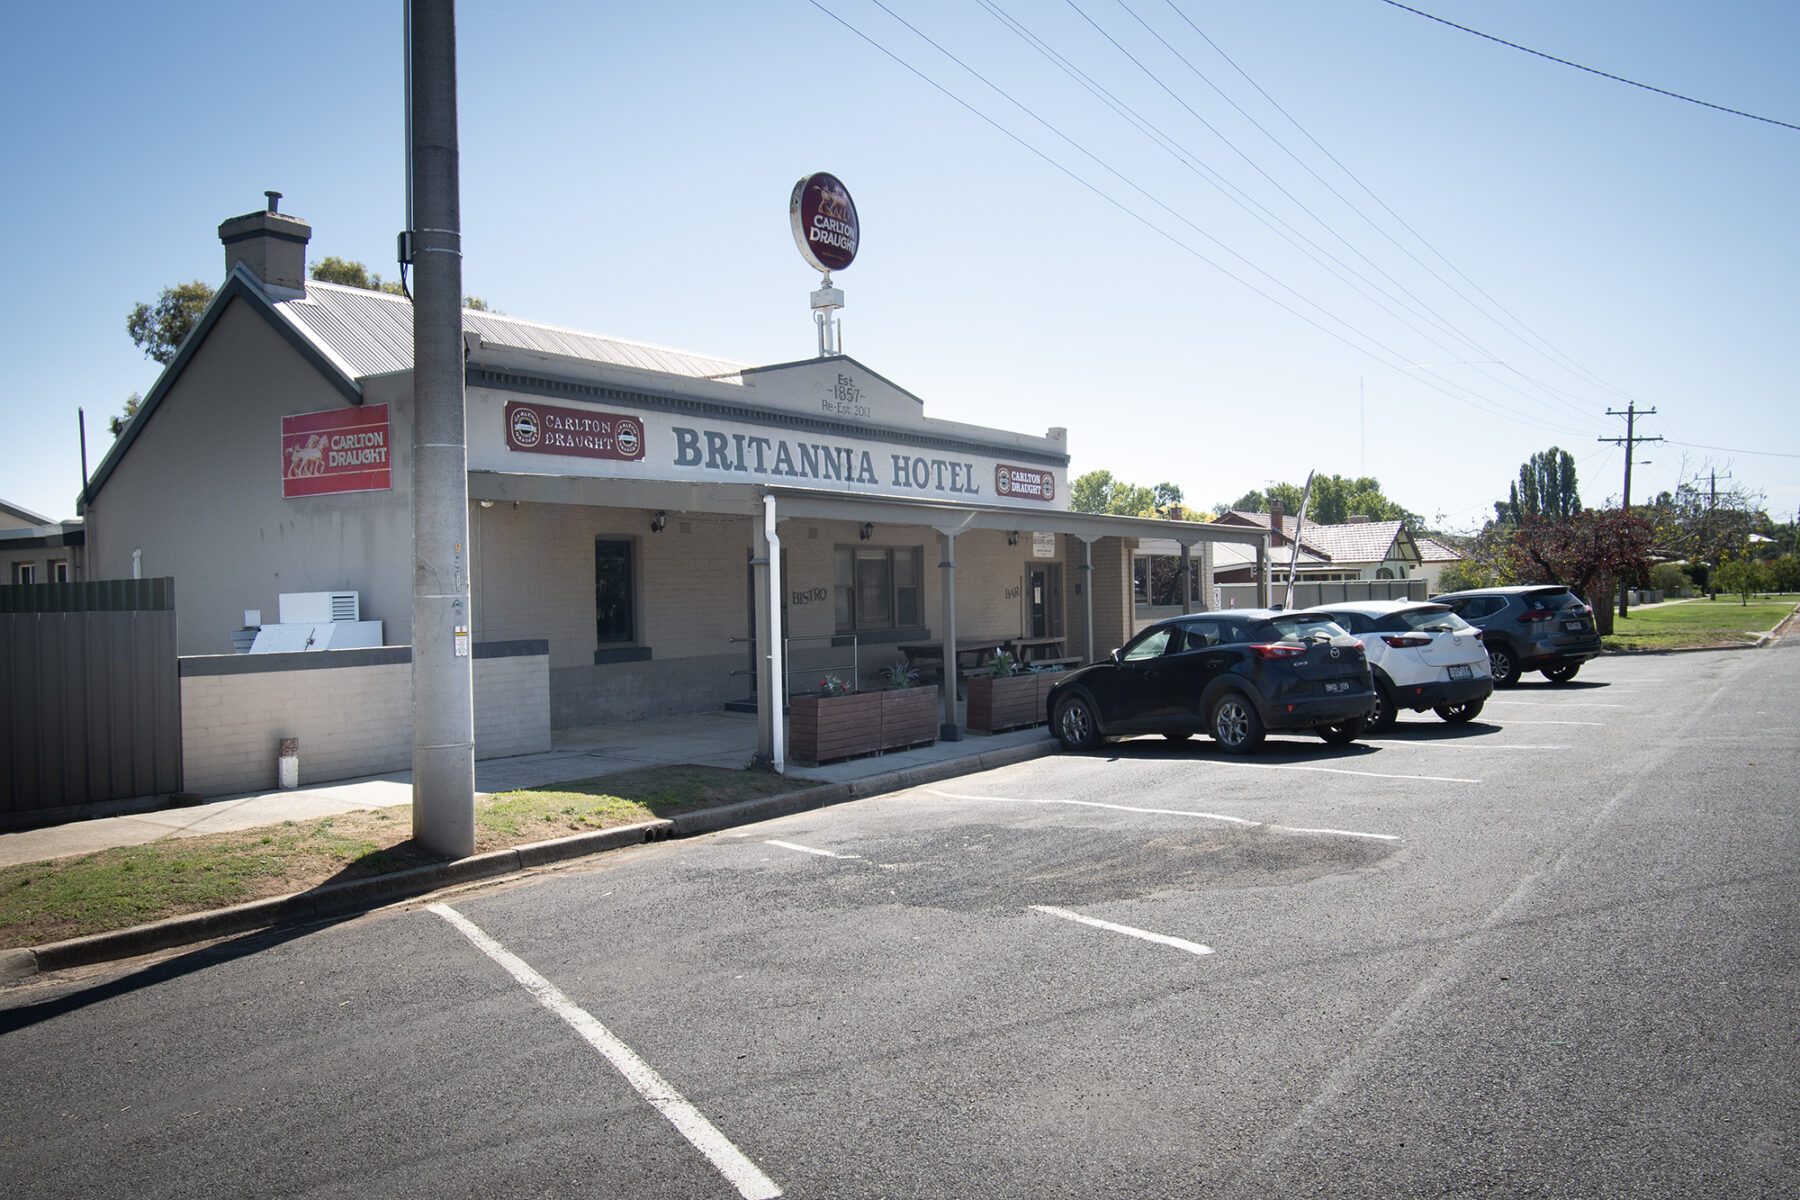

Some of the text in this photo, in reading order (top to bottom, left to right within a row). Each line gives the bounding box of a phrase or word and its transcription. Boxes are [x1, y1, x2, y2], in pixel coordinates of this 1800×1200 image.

[813, 214, 855, 239] CARLTON
[809, 227, 856, 253] DRAUGHT
[545, 415, 611, 433] CARLTON
[331, 432, 384, 450] CARLTON
[545, 432, 613, 450] DRAUGHT
[329, 448, 387, 467] DRAUGHT
[672, 426, 879, 485] BRITANNIA
[891, 454, 980, 494] HOTEL
[1011, 471, 1041, 484] CARLTON
[1011, 481, 1041, 495] DRAUGHT
[792, 587, 828, 605] BISTRO
[1005, 586, 1021, 599] BAR
